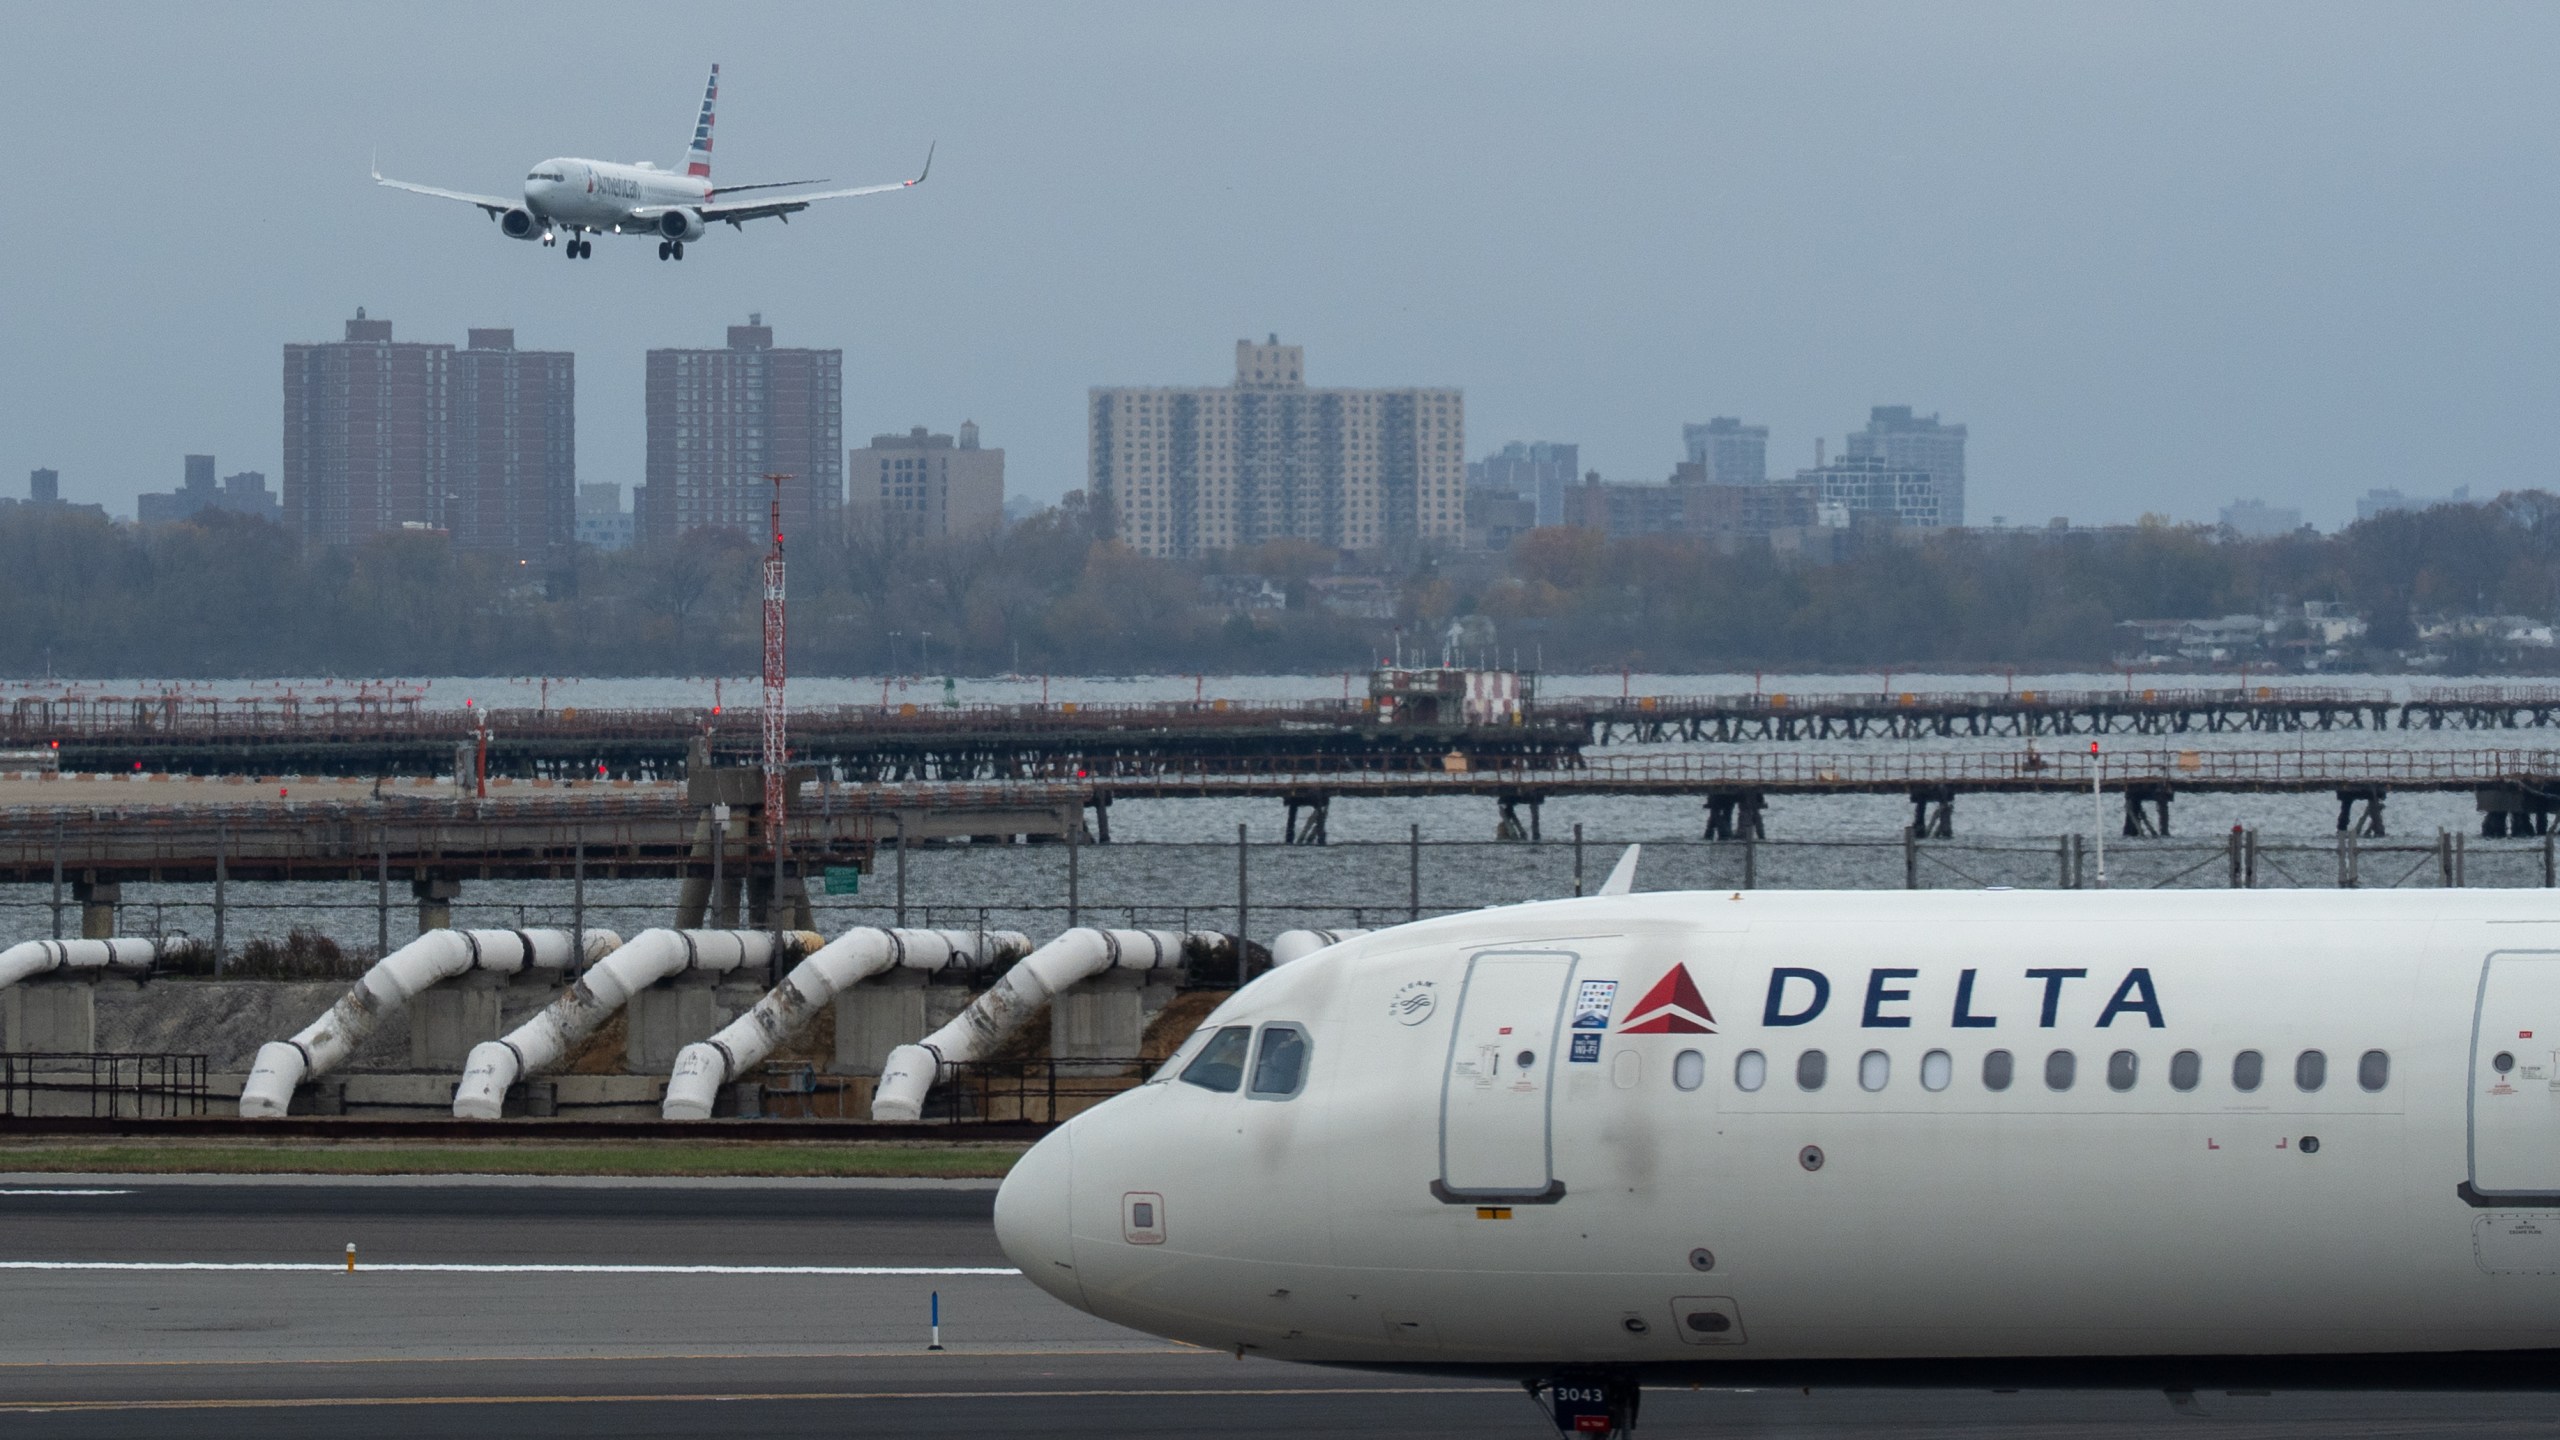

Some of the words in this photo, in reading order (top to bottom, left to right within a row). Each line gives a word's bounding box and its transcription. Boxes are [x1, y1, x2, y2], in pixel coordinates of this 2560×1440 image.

[596, 171, 641, 200] American
[1762, 967, 2166, 1028] DELTA
[1558, 1387, 1602, 1401] 3043
